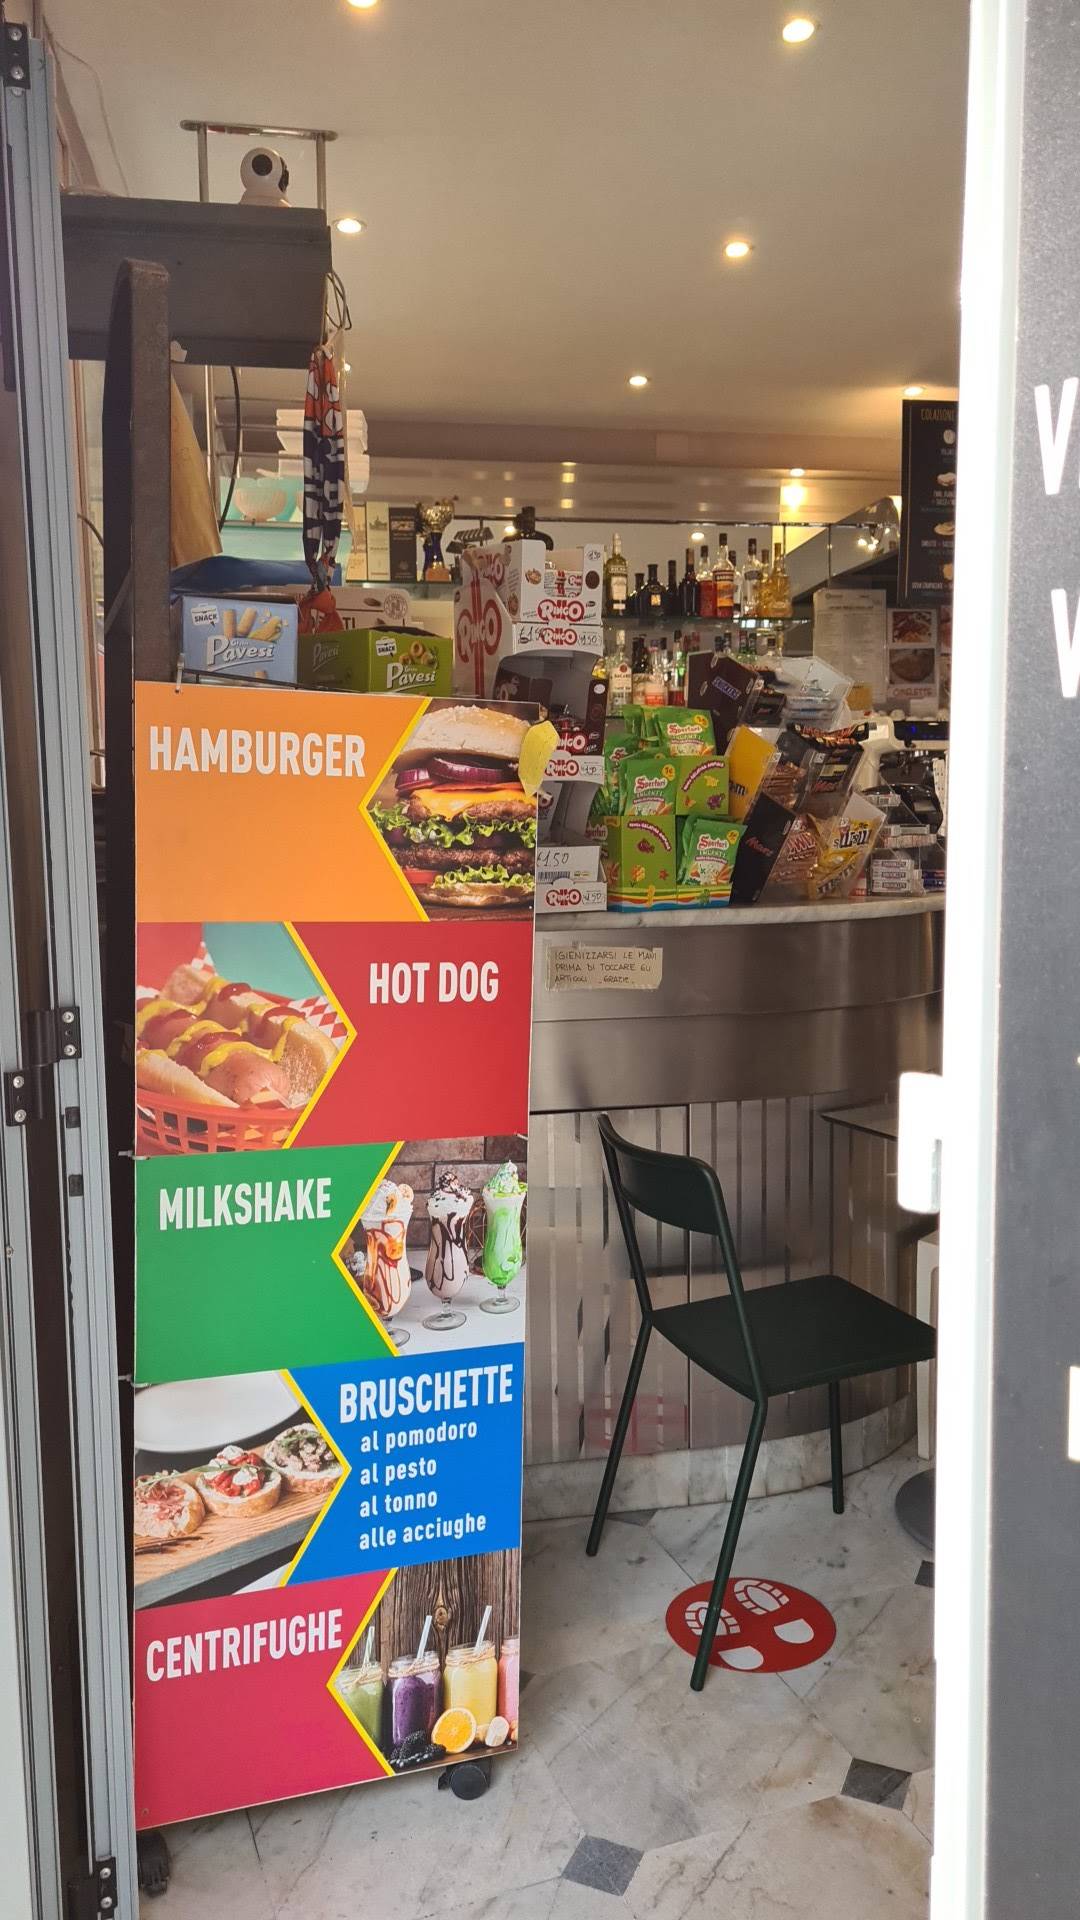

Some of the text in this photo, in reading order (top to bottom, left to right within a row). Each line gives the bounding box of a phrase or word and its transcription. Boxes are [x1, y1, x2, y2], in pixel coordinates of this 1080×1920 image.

[194, 613, 217, 623] SNACK
[207, 634, 274, 666] Pavesi
[378, 646, 396, 654] SNACK
[386, 662, 436, 689] Pavesi
[149, 725, 366, 779] HAMBURGER
[555, 963, 582, 972] PRIMA
[587, 963, 595, 972] DI
[600, 962, 635, 972] TOCCARE
[623, 951, 633, 960] LE
[638, 951, 657, 960] MANI
[369, 960, 500, 1005] HOT DOG
[159, 1177, 332, 1231] MILKSHAKE
[339, 1363, 513, 1424] BRUSCHETTE
[360, 1421, 478, 1454] al pomodoro
[360, 1457, 437, 1486] al pesto
[359, 1490, 438, 1518] al tonno
[359, 1512, 486, 1550] alle acciughe
[146, 1608, 343, 1682] CENTRIFUGHE
